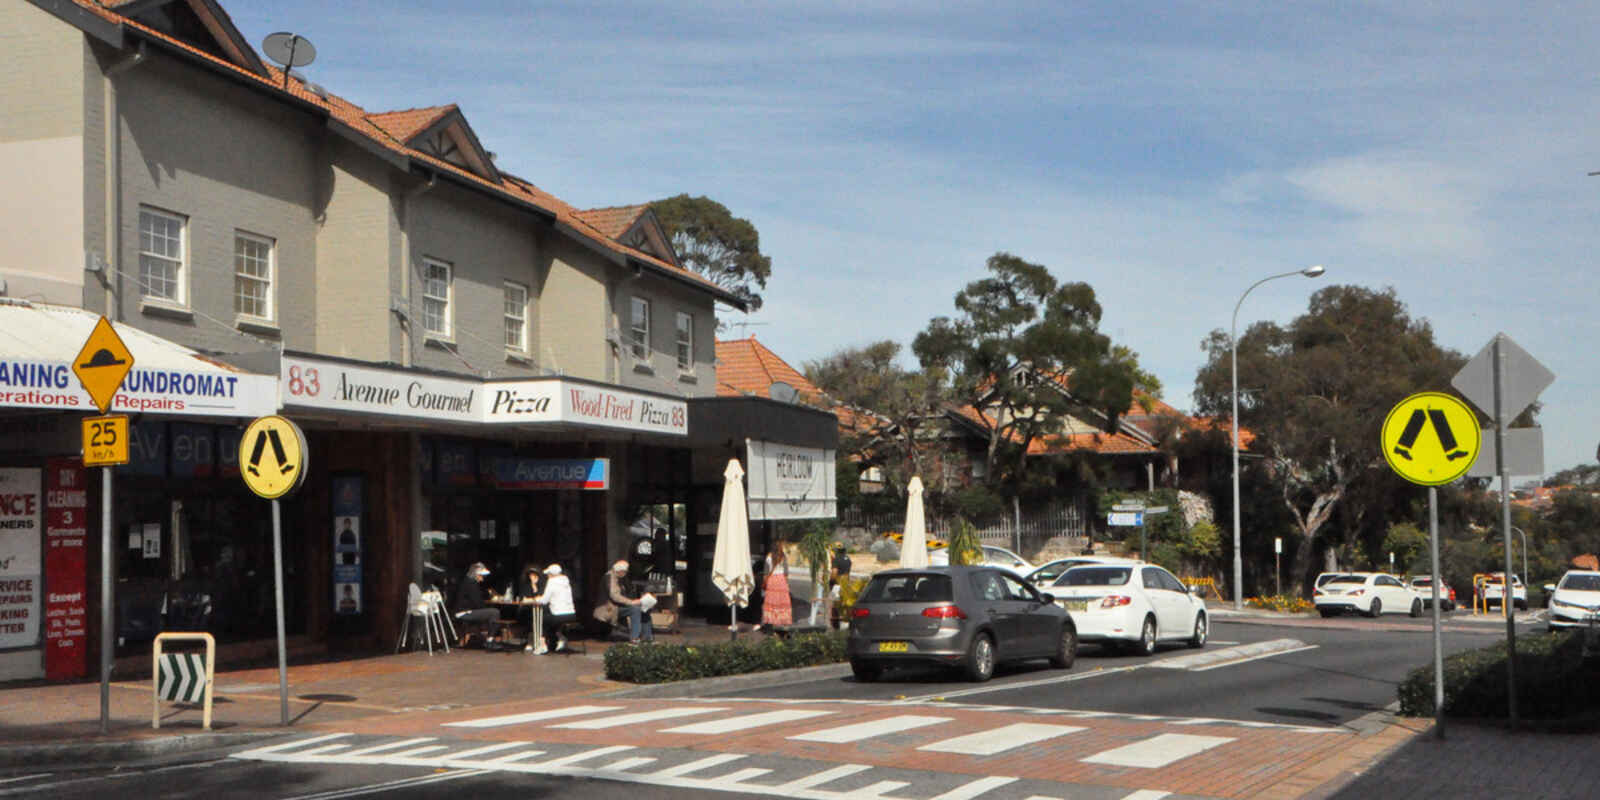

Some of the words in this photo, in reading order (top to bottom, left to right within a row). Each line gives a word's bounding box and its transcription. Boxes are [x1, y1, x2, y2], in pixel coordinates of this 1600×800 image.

[288, 365, 321, 396] 83
[334, 372, 399, 404] Avenue
[406, 381, 474, 413] Gourmet
[115, 394, 185, 412] Repairs
[491, 390, 551, 415] Pizza
[569, 389, 634, 421] Wood-Fired
[639, 401, 669, 425] Pizza
[671, 406, 685, 427] 83
[91, 422, 117, 447] 25
[514, 461, 586, 481] Avenue
[63, 511, 73, 525] 3
